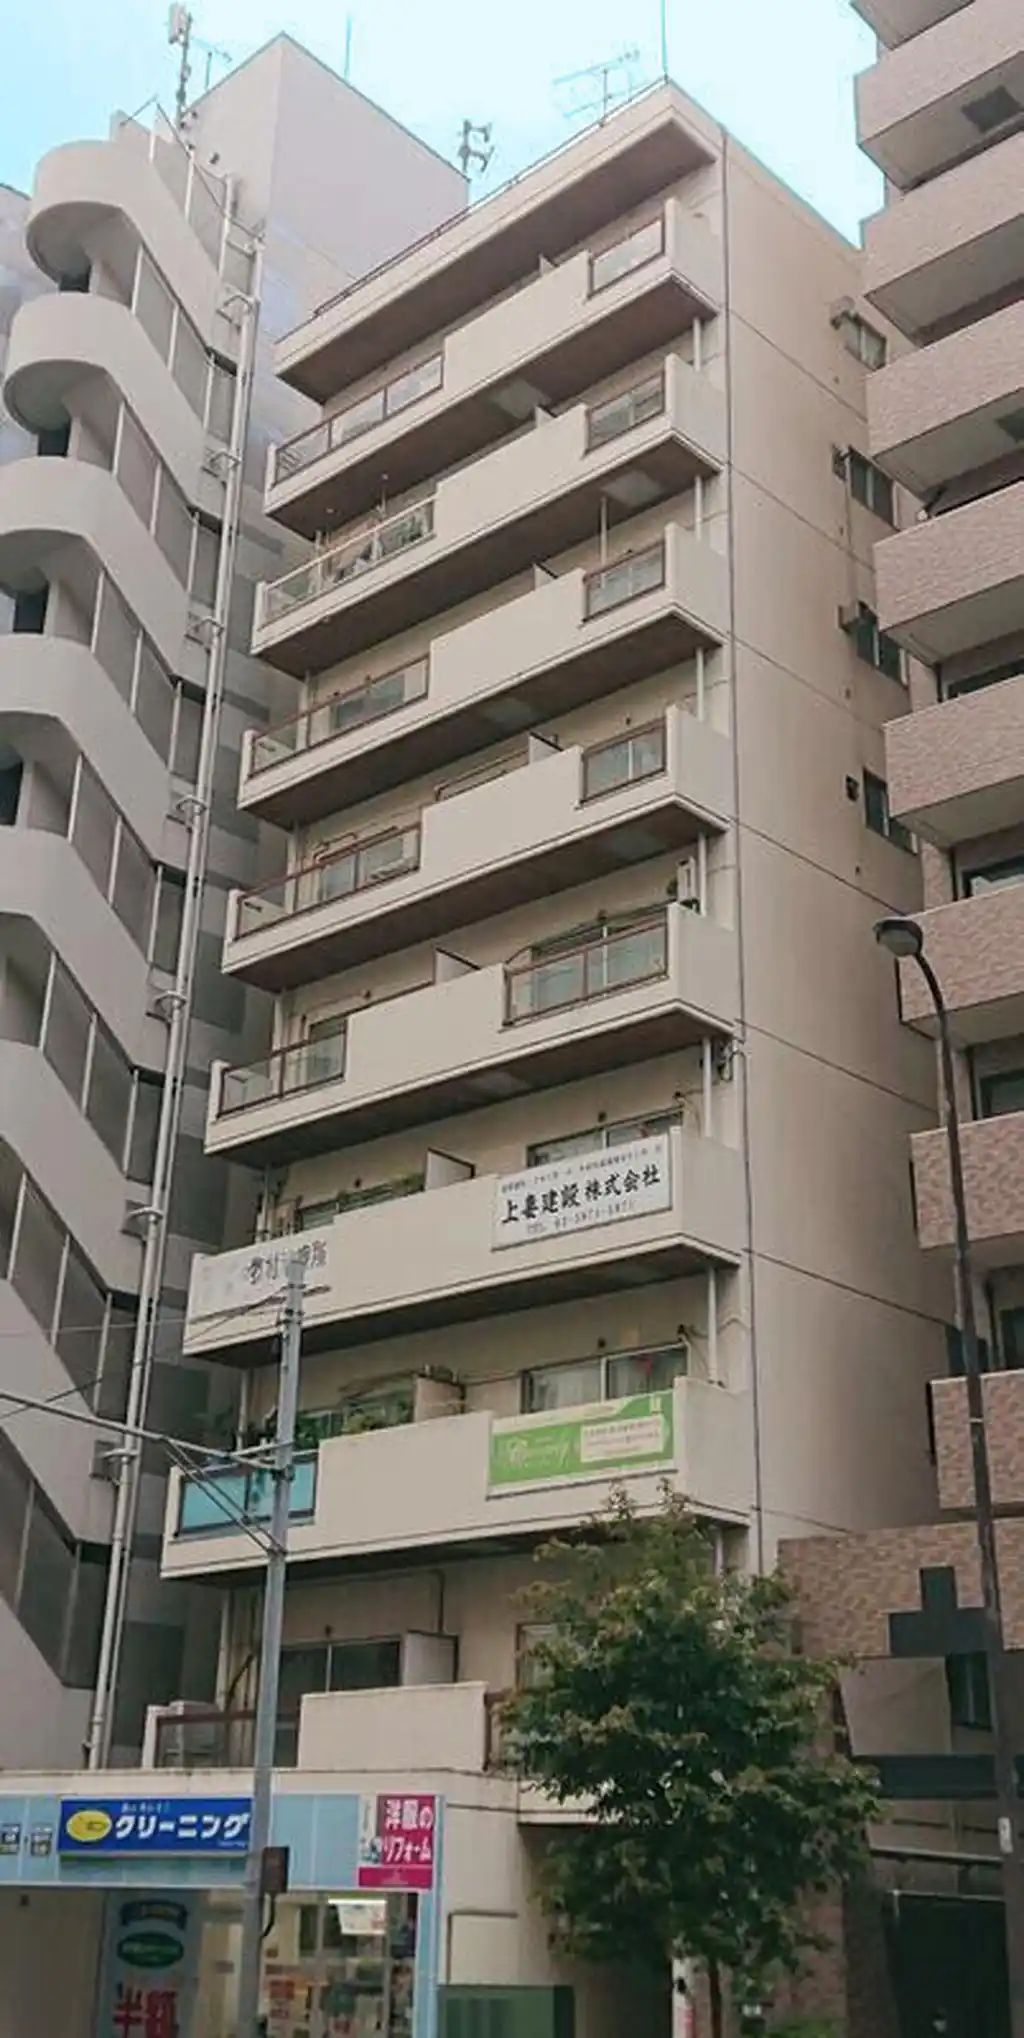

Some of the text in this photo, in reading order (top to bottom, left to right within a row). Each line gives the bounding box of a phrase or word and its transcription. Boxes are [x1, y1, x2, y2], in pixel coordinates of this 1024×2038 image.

[115, 1812, 250, 1840] クリーニング
